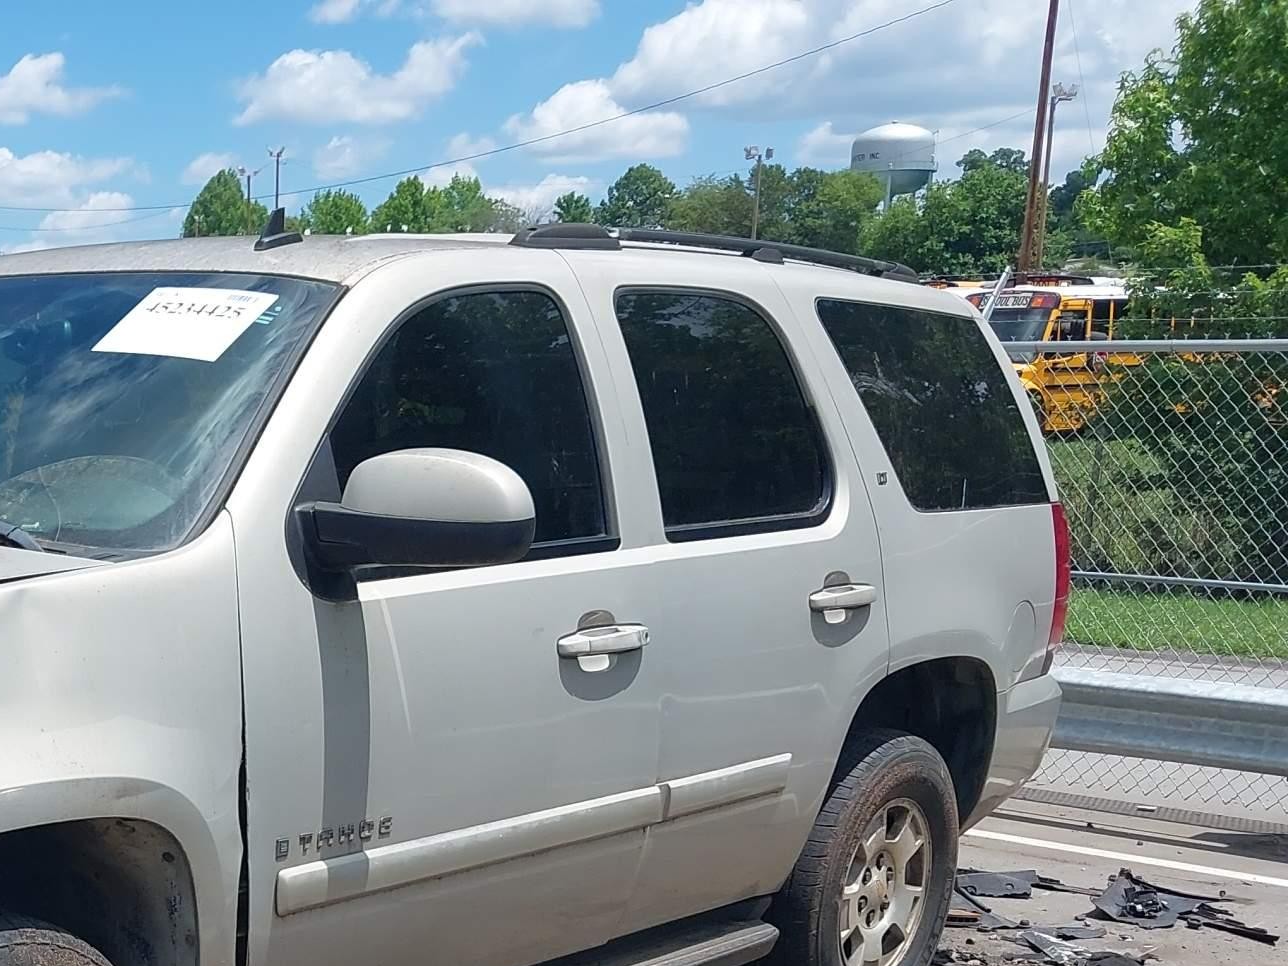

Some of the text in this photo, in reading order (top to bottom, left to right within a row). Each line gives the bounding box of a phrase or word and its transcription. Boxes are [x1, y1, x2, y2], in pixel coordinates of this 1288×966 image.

[1013, 296, 1030, 307] BUS
[145, 302, 247, 320] 45234425
[298, 816, 393, 856] TAHOE
